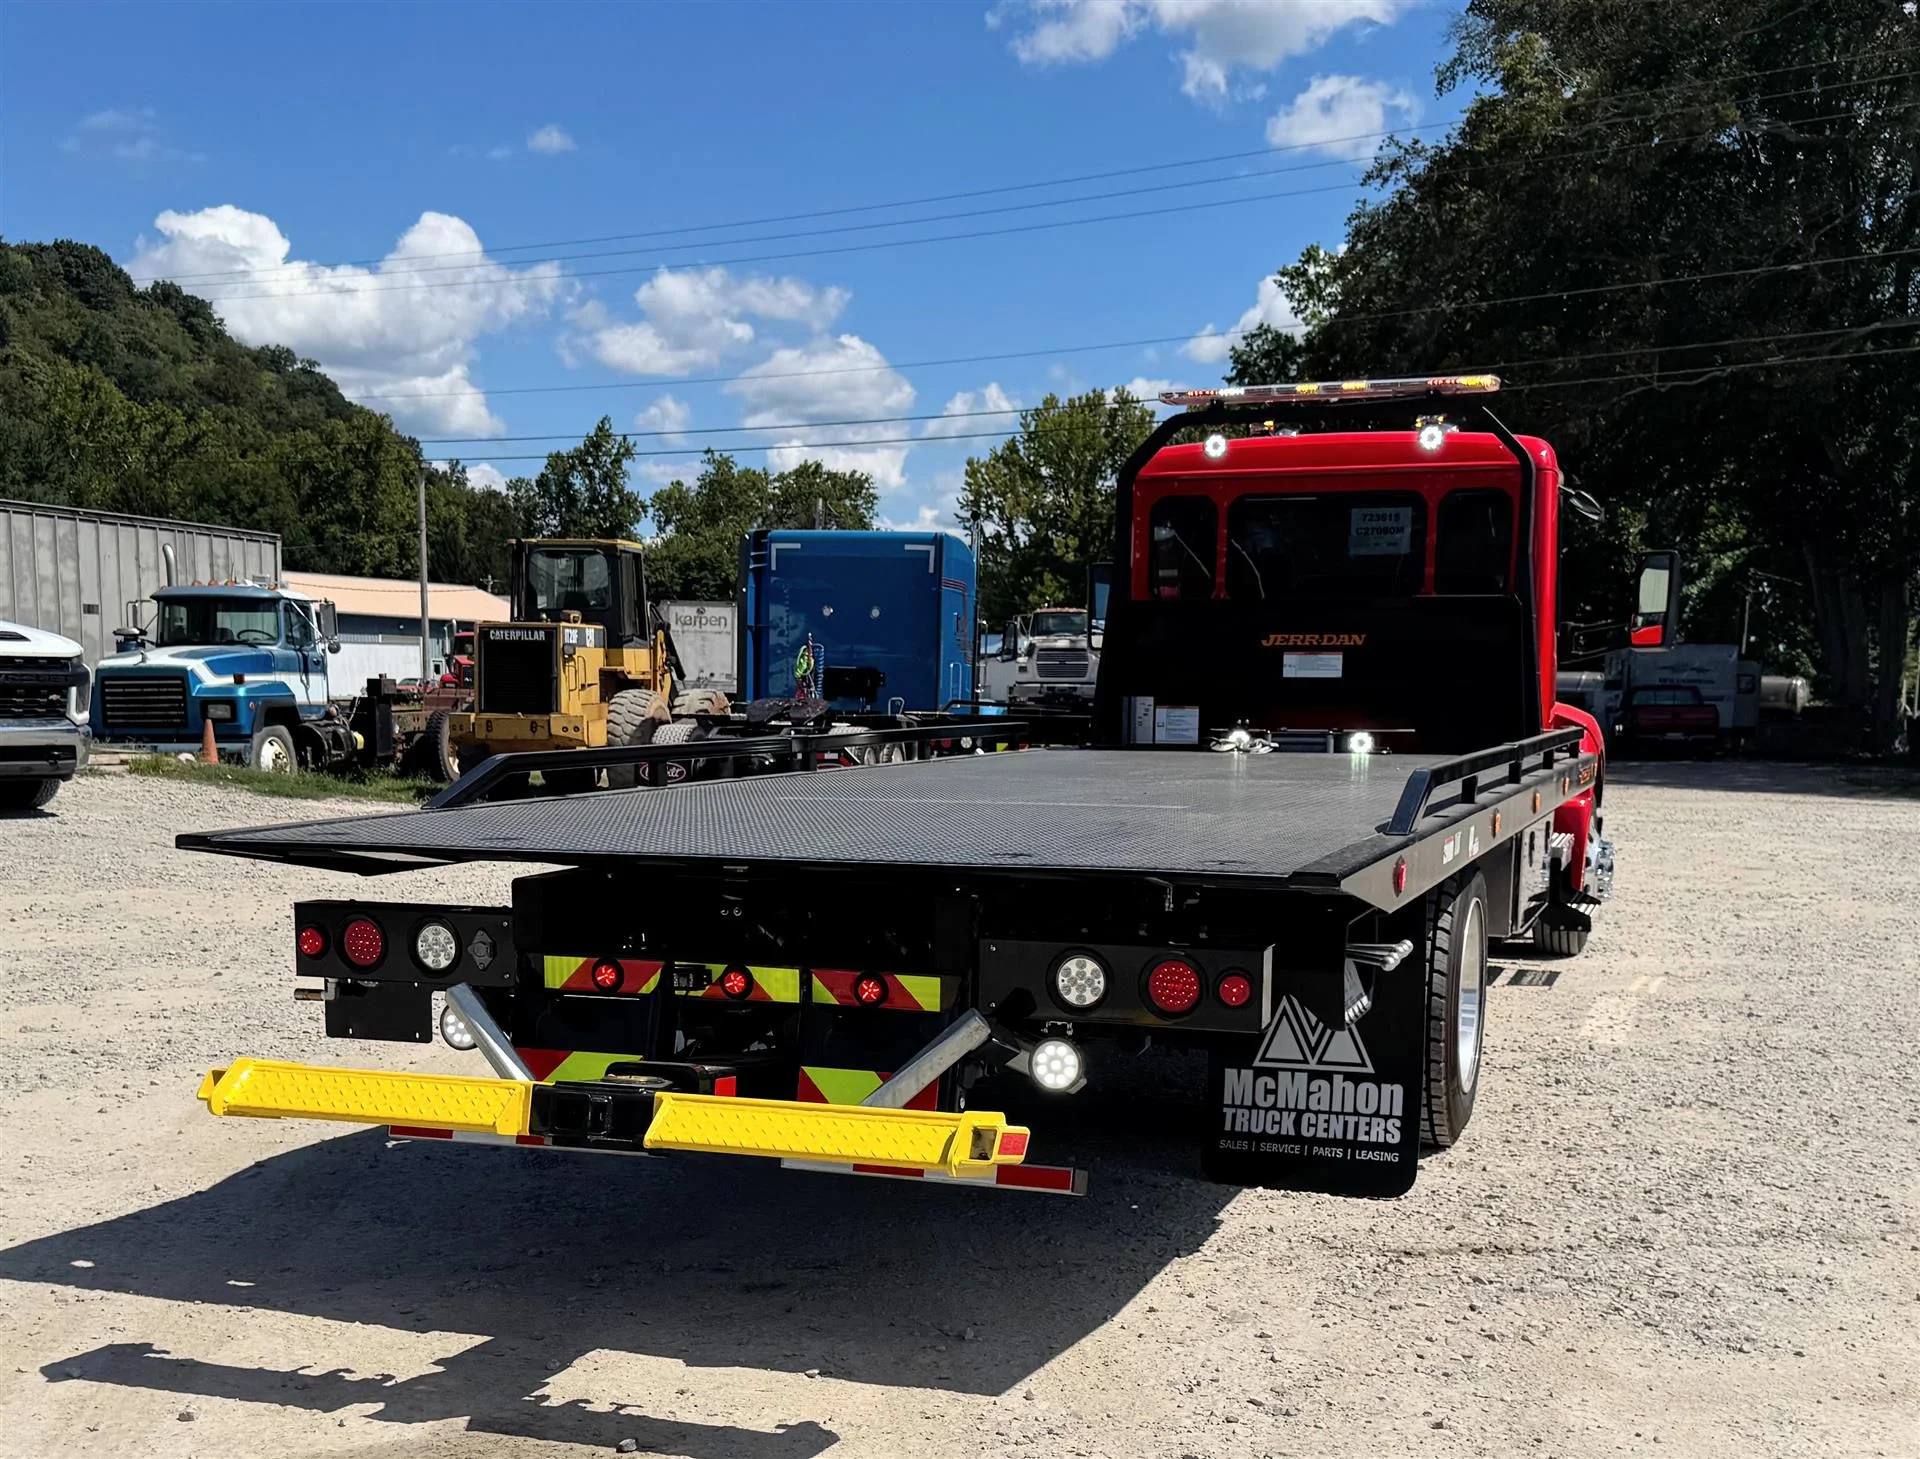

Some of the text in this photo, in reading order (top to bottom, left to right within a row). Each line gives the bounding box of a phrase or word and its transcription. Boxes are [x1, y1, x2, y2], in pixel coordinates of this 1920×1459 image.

[675, 612, 727, 629] karpen
[489, 630, 546, 641] CATERPILLAR
[1223, 1068, 1404, 1116] McMahon
[1222, 1107, 1401, 1144] TRUCK CENTERS
[1219, 1139, 1399, 1163] SALES SERVICE PARTS LEASING
